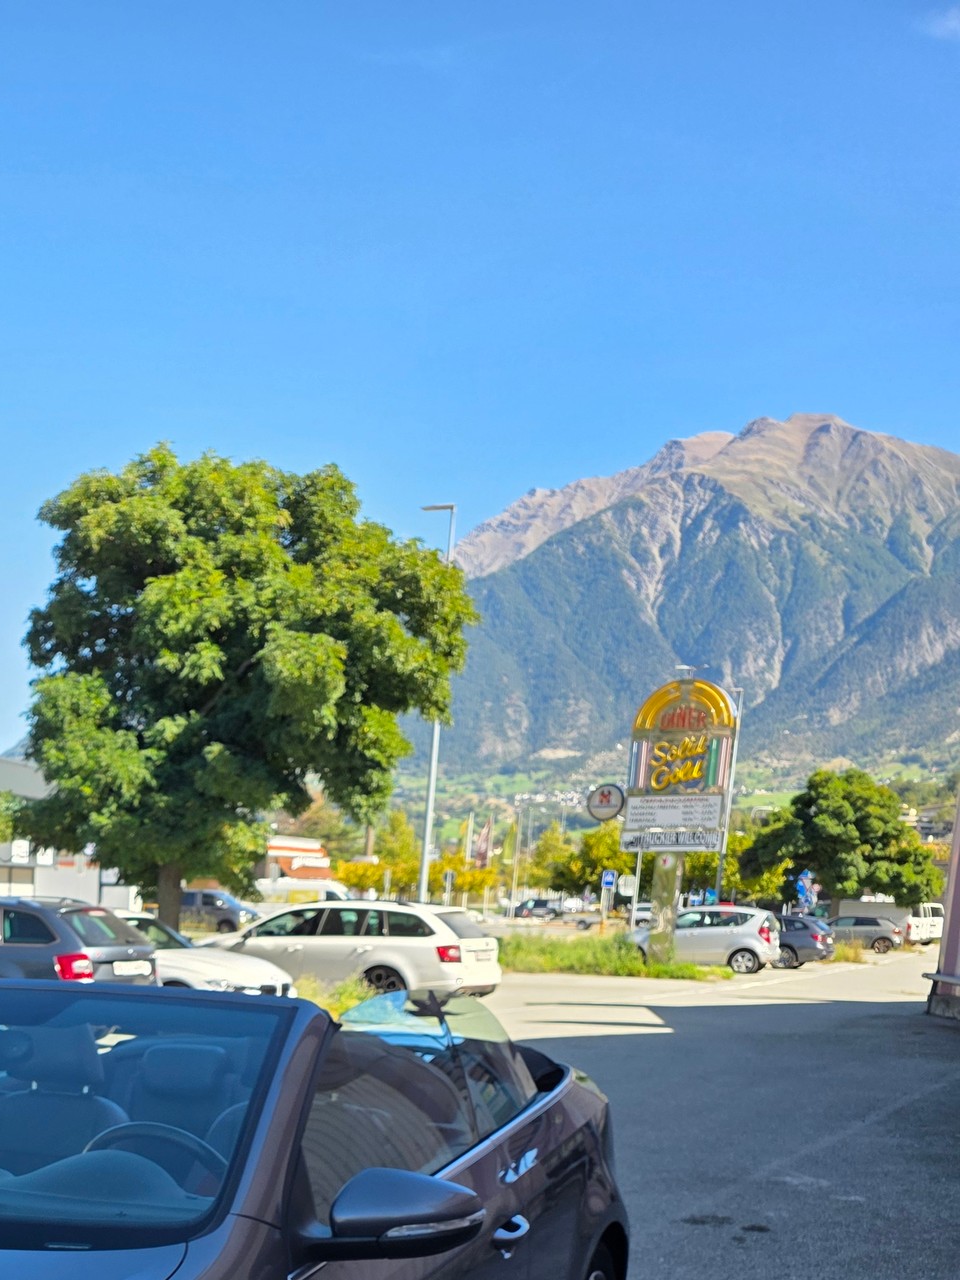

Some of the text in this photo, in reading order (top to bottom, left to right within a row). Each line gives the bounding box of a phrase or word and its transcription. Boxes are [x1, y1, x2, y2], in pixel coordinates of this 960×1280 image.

[660, 704, 707, 731] DINER
[650, 735, 708, 767] Solid
[650, 760, 704, 791] Gold
